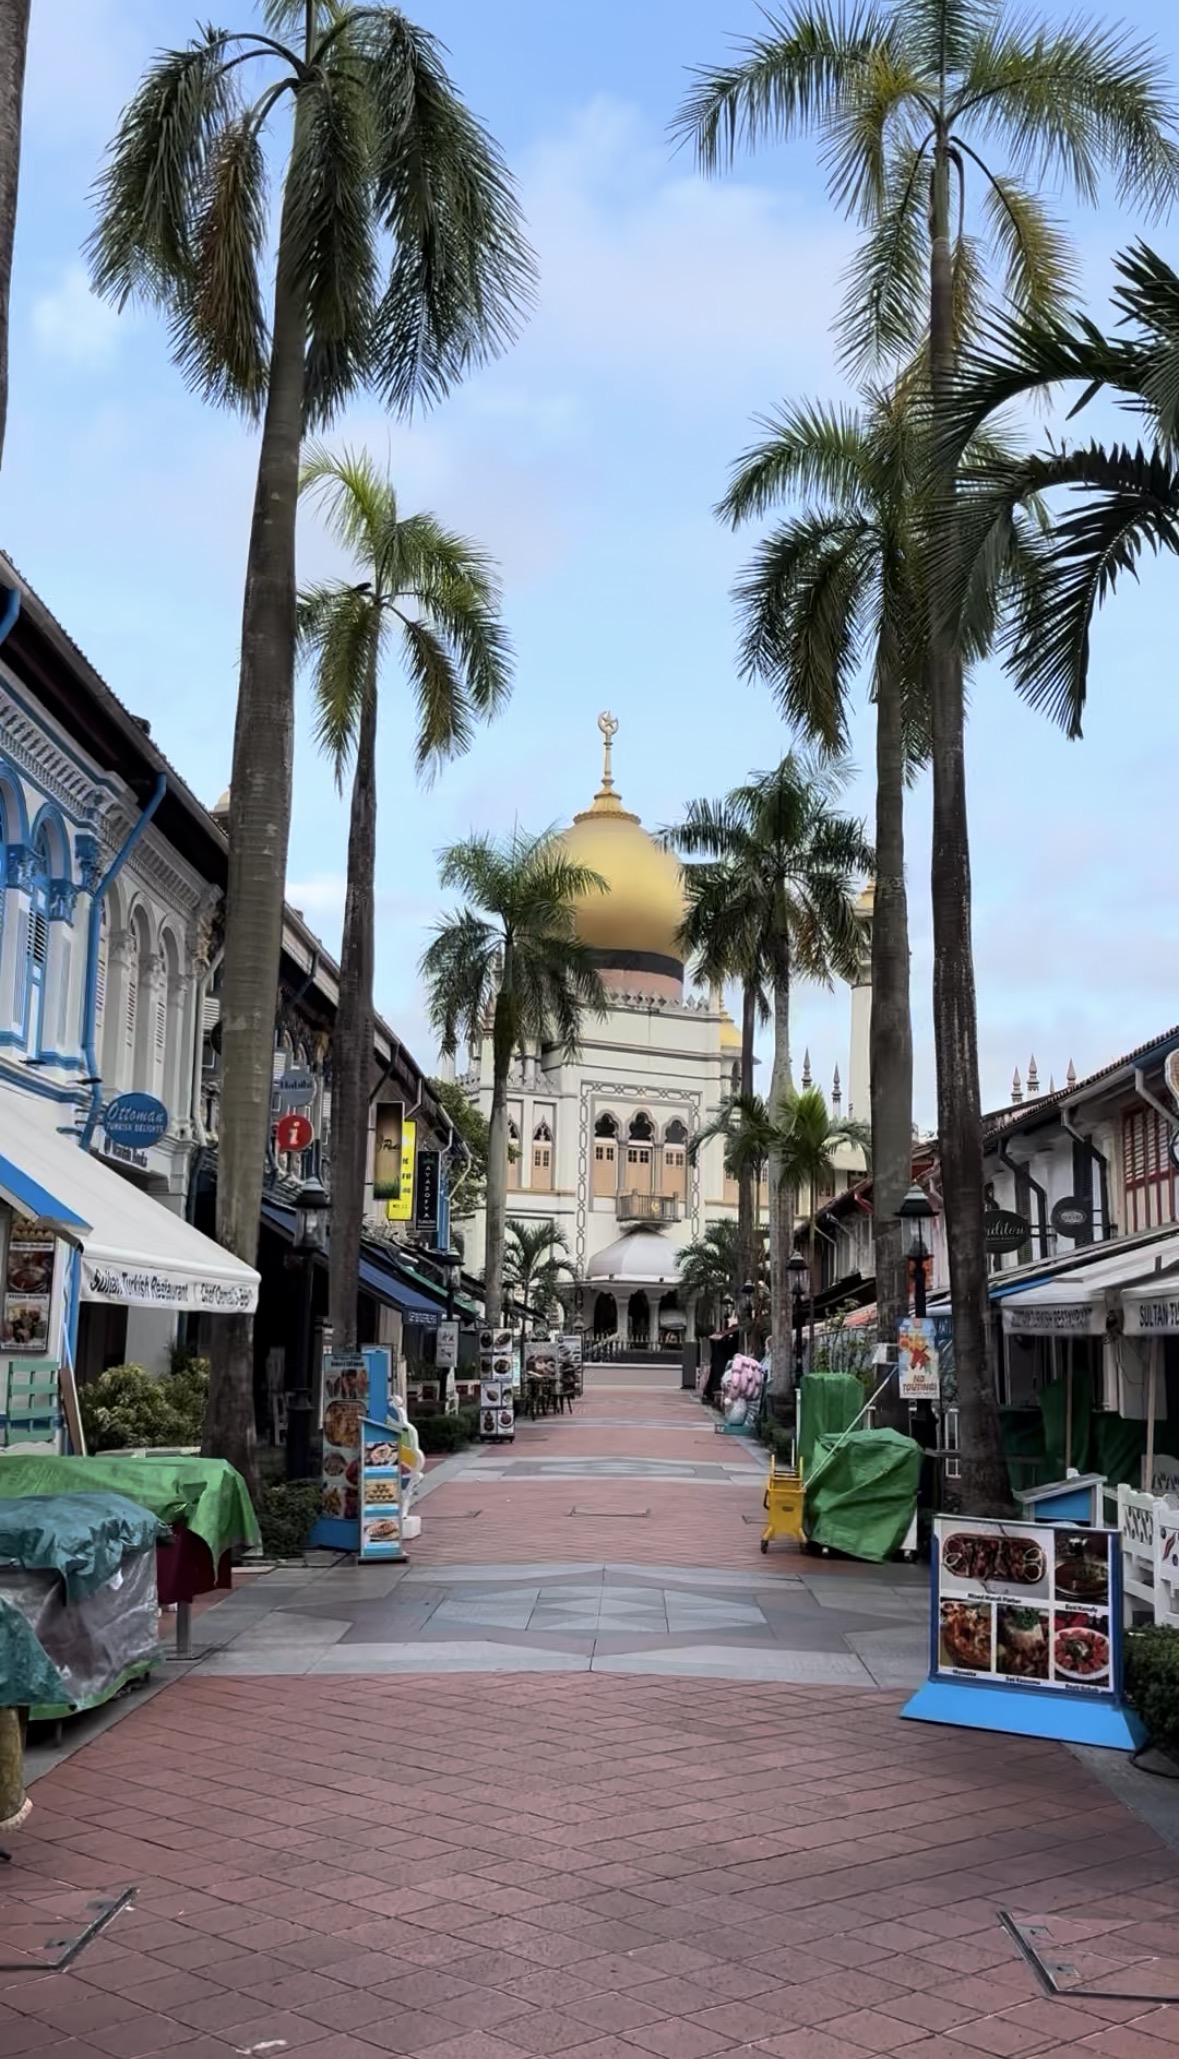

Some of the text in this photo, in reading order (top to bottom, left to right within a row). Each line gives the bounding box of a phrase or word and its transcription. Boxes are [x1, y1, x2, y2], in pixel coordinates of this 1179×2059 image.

[107, 1102, 164, 1123] Ottoman
[121, 1272, 149, 1297] Turkish
[150, 1275, 189, 1301] Restaurant
[1139, 1303, 1169, 1328] SULTAN
